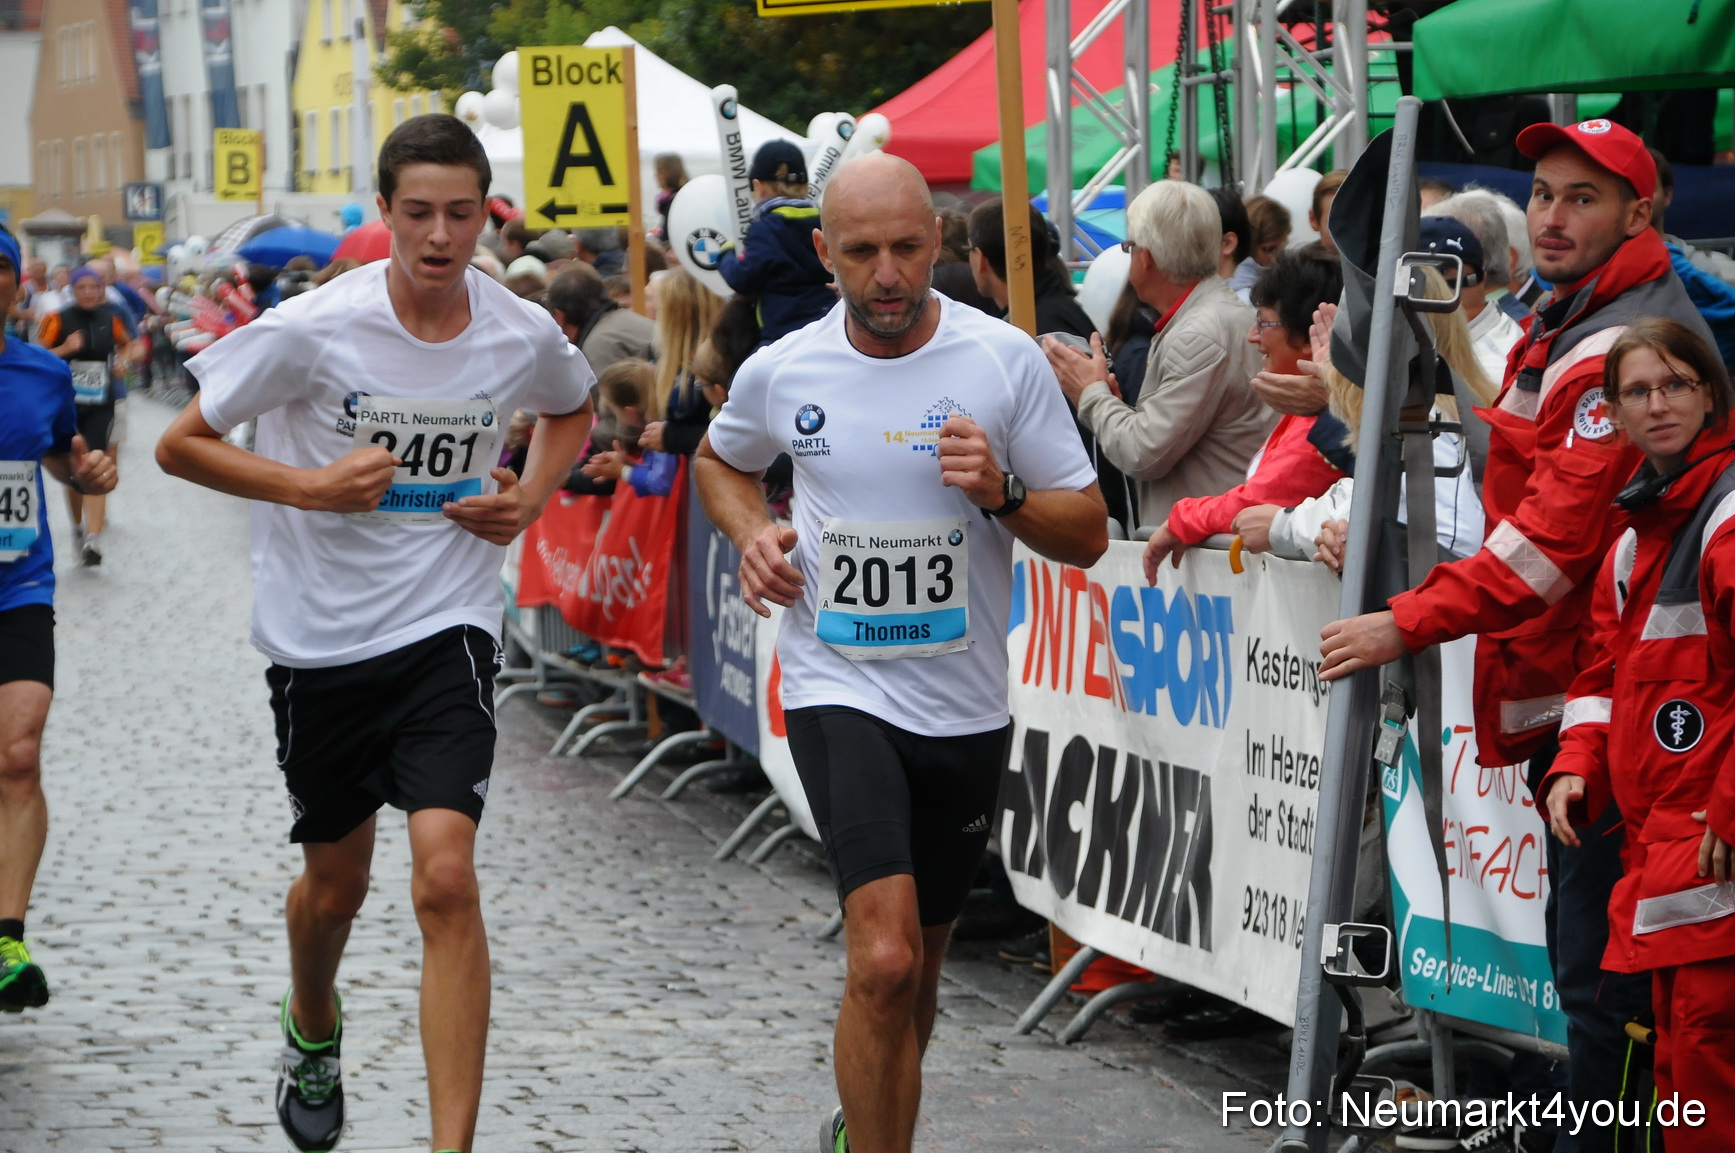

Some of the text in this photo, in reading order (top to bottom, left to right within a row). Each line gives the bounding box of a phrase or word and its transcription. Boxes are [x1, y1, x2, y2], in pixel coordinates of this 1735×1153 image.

[532, 53, 623, 86] Block
[549, 102, 615, 187] A
[726, 131, 751, 181] BMW
[229, 152, 249, 184] B
[360, 410, 476, 426] PARTL Neumarkt
[792, 438, 831, 450] PARTL
[795, 449, 831, 457] Neumarkt
[883, 431, 908, 443] 14.
[370, 431, 479, 478] 2461
[0, 471, 24, 481] markt
[822, 531, 942, 549] PARTL Neumarkt
[833, 554, 954, 608] 2013
[822, 599, 829, 609] A
[852, 620, 931, 642] Thomas
[1022, 557, 1234, 730] INTERSPORT
[1246, 728, 1265, 778] Im
[1271, 733, 1320, 791] Herze
[1248, 792, 1315, 856] der Stadt
[1242, 884, 1288, 943] 92318
